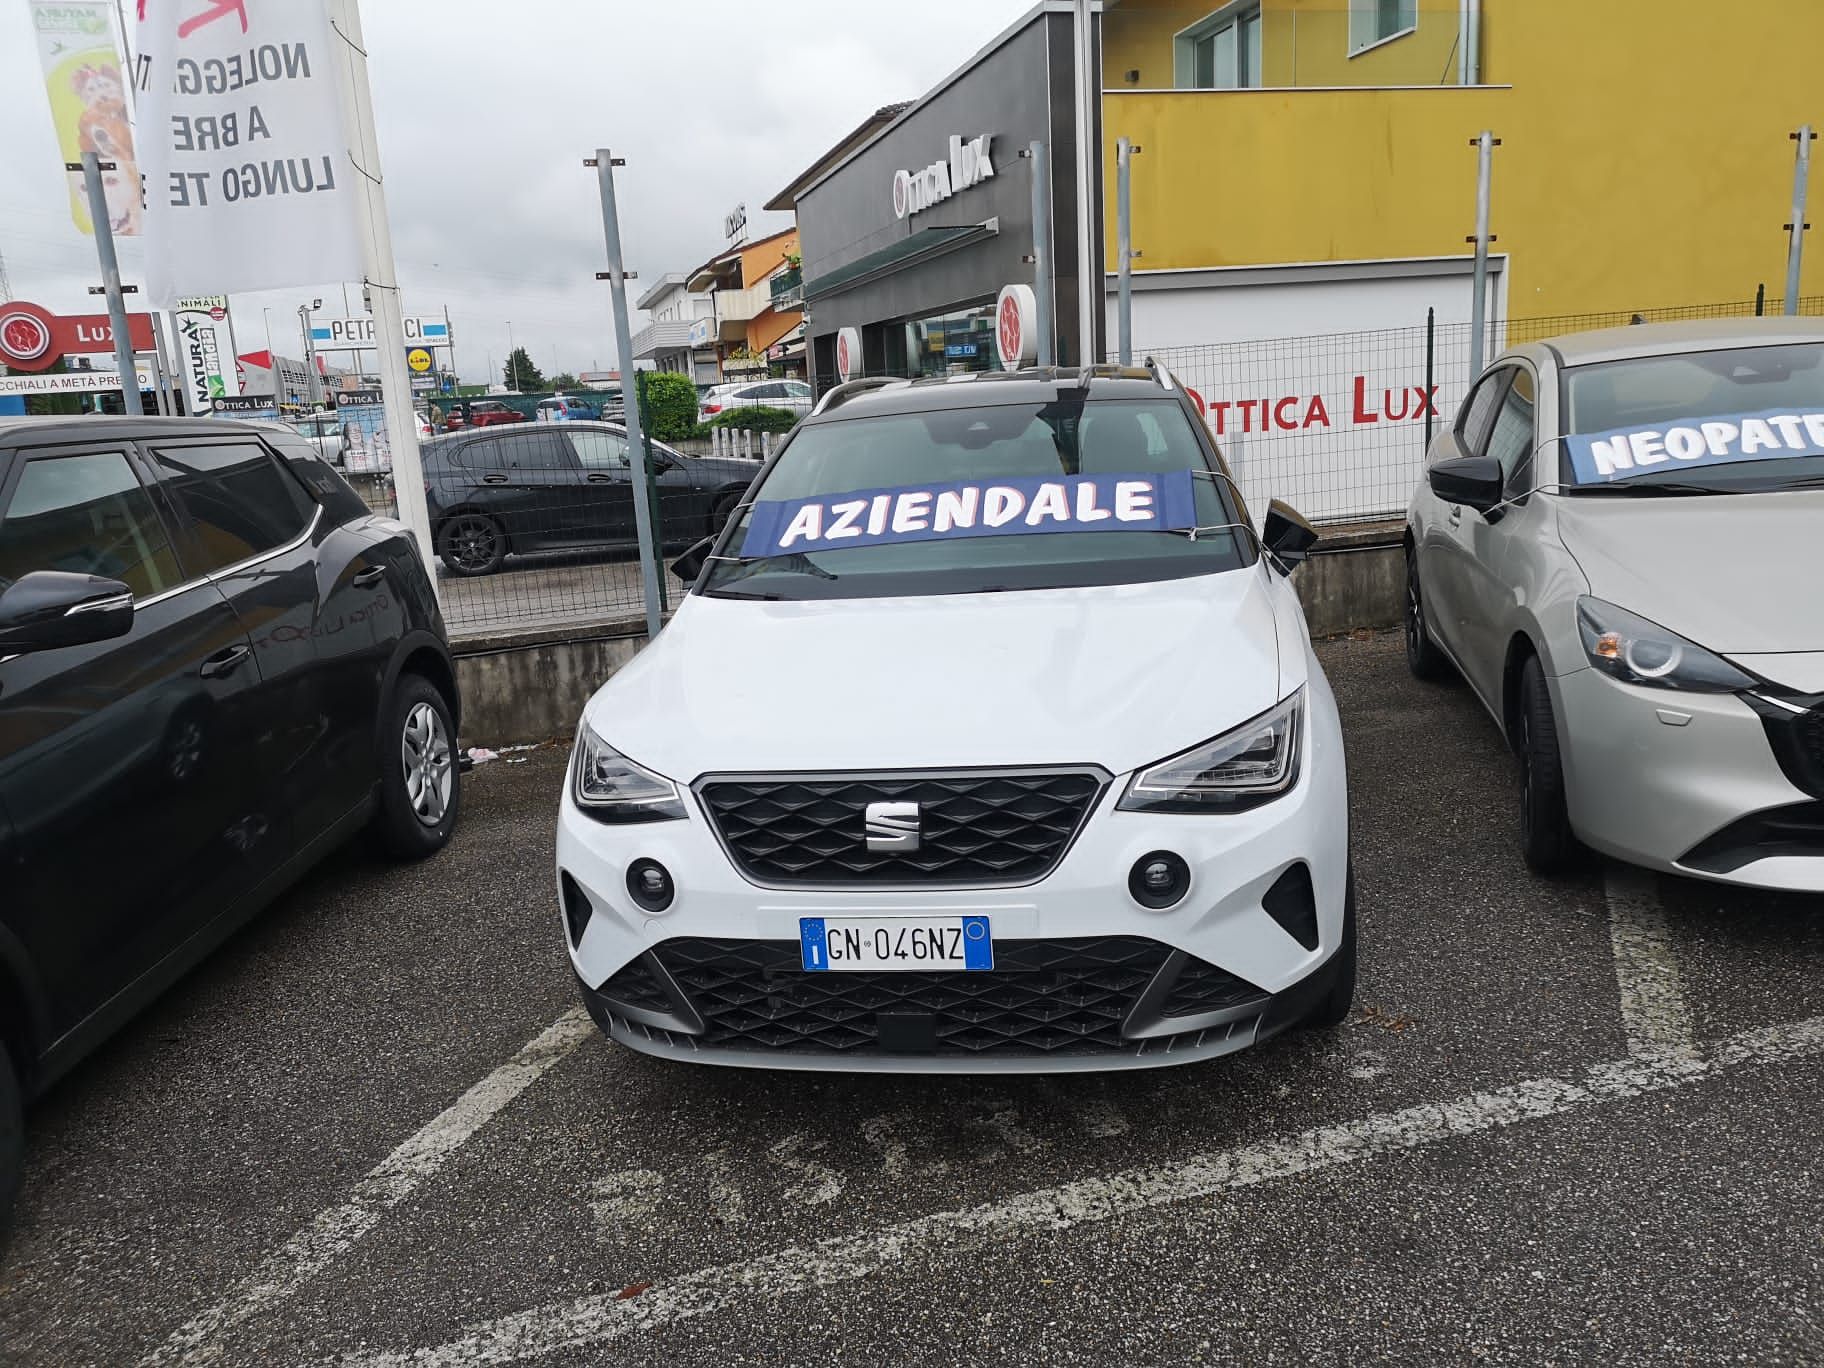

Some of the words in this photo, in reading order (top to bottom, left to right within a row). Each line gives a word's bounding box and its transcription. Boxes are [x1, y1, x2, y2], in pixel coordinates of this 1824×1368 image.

[177, 298, 221, 308] NIMALI
[331, 318, 422, 341] PETRCI
[188, 327, 210, 403] NATURA
[50, 379, 59, 389] A
[98, 374, 147, 386] PREO
[778, 479, 1156, 549] AZIENDALE
